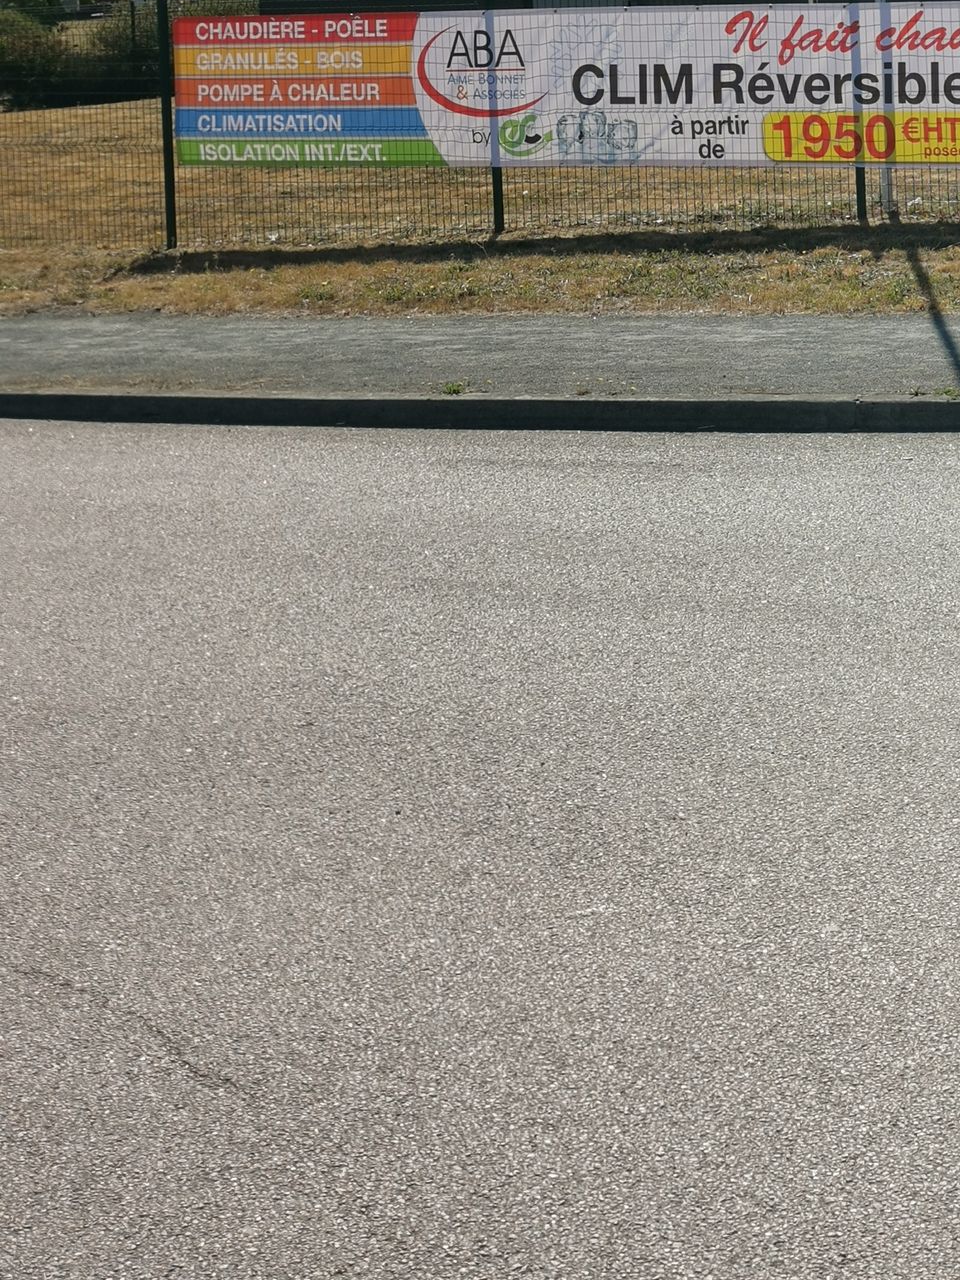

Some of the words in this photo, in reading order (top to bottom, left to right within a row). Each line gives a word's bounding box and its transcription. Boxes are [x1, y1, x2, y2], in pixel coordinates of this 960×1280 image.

[195, 18, 305, 40] CHAUDIÈRE
[324, 16, 388, 38] POÊLE
[724, 11, 769, 54] Il
[778, 14, 860, 66] fait
[196, 49, 299, 70] GRANULÉS
[317, 51, 363, 69] BOIS
[447, 29, 525, 68] ABA
[479, 73, 525, 85] BONNET
[572, 63, 693, 106] CLIM
[197, 84, 264, 102] POMPE
[270, 80, 283, 102] À
[288, 83, 380, 101] CHALEUR
[198, 115, 341, 132] CLIMATISATION
[671, 115, 683, 135] à
[691, 116, 749, 139] partir
[772, 114, 896, 159] 1950
[201, 144, 299, 161] ISOLATION
[305, 143, 386, 161] INT./EXT.
[698, 139, 725, 159] de
